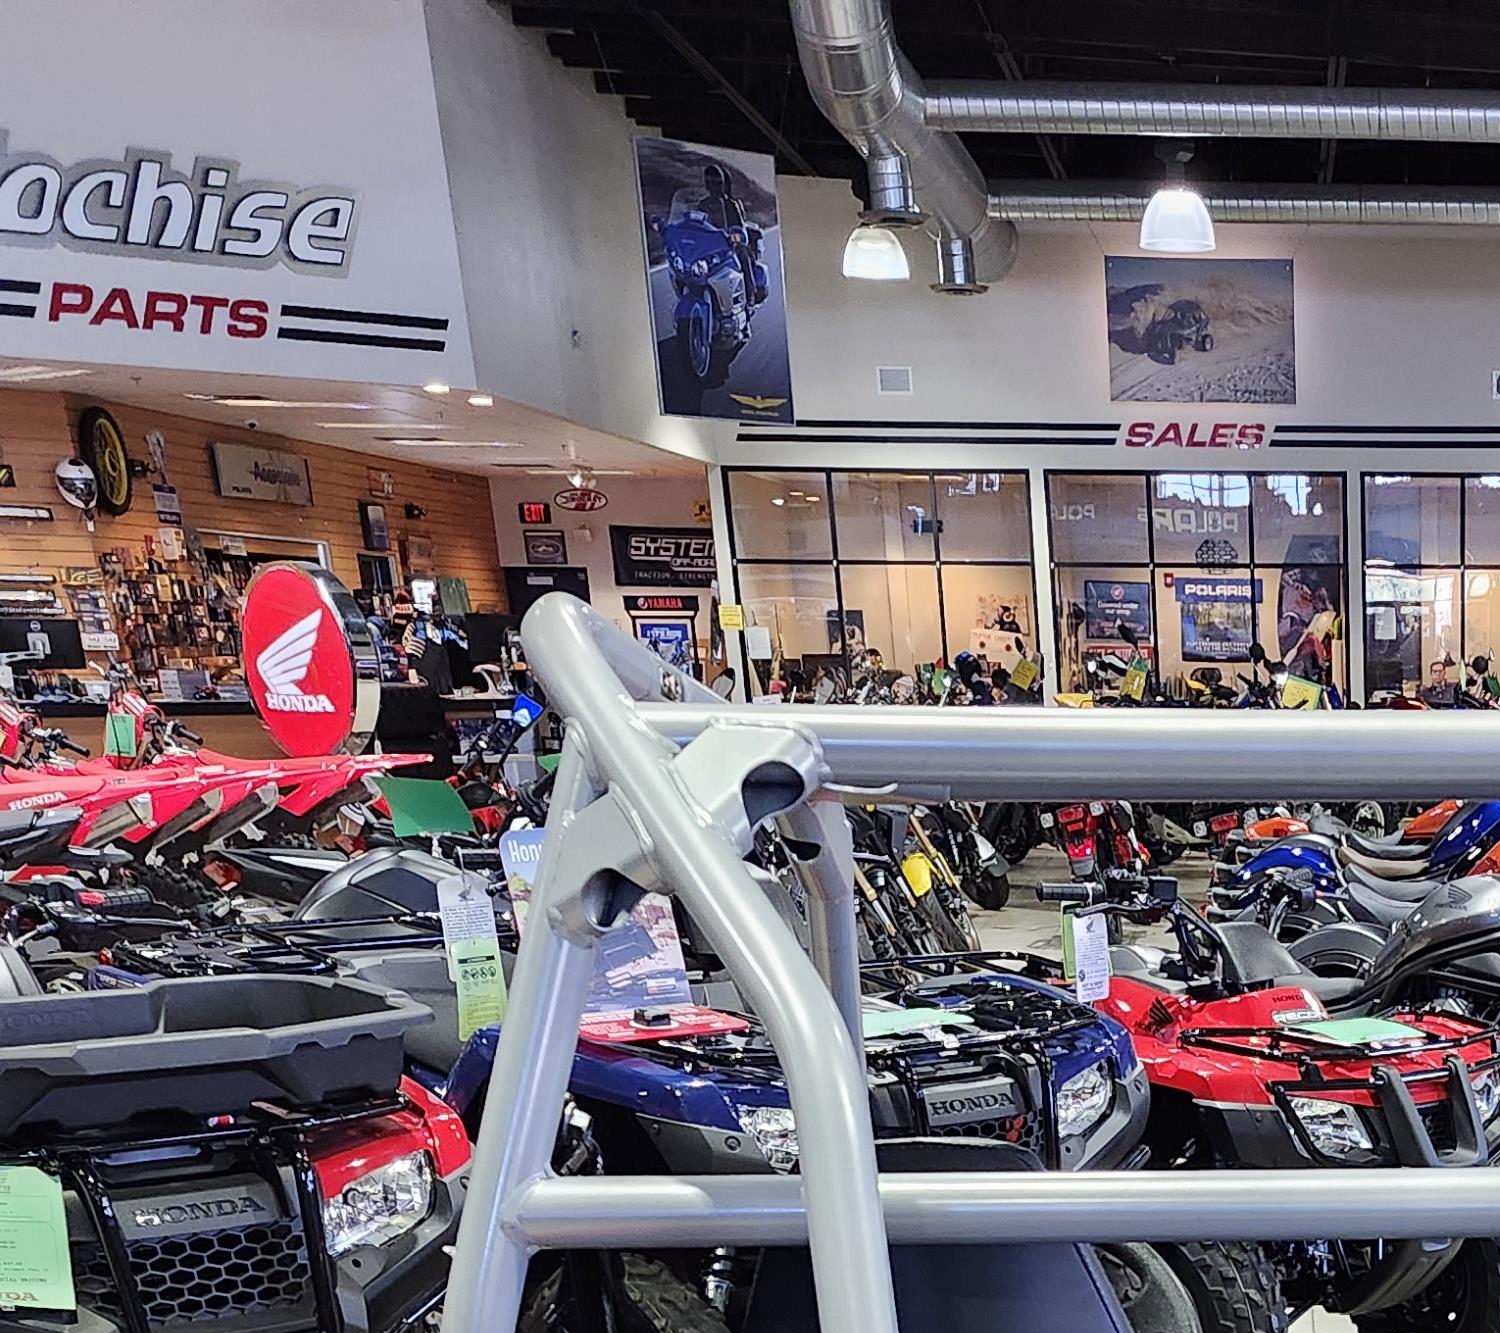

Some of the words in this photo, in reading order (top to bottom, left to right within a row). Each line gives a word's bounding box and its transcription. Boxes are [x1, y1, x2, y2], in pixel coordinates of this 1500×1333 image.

[0, 159, 356, 266] ochise
[49, 281, 270, 339] PARTS
[1125, 422, 1266, 448] SALES
[524, 504, 545, 522] EXIT
[1184, 583, 1252, 597] POLARIS
[647, 597, 683, 609] YAMAHA
[264, 692, 336, 713] HONDA
[8, 791, 69, 811] HONDA
[1272, 994, 1304, 1004] HOND
[929, 1092, 1017, 1116] HONDA
[132, 1196, 267, 1228] HONDA
